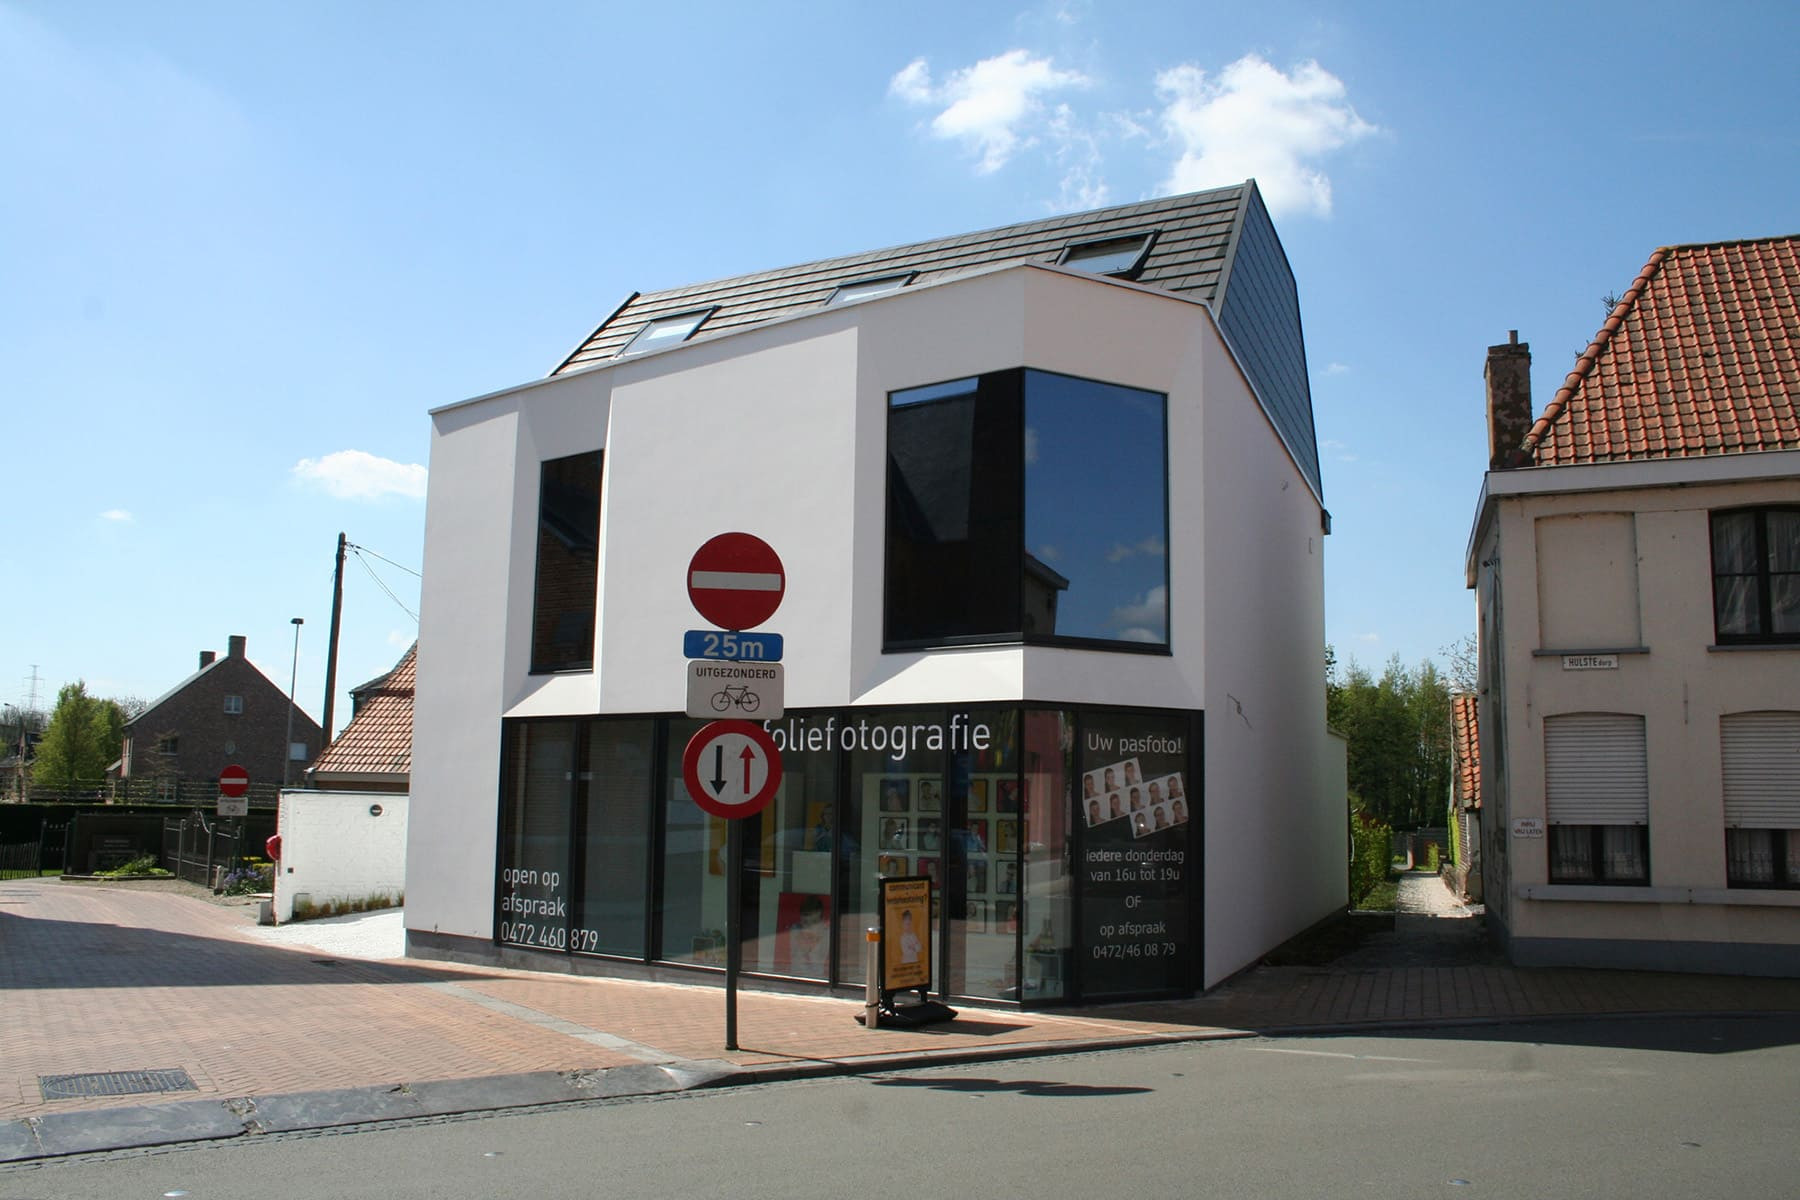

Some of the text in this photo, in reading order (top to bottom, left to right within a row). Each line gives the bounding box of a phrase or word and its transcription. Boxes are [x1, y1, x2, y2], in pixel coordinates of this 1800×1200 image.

[703, 633, 764, 658] 25m
[1568, 657, 1598, 667] HULSTE
[696, 667, 776, 679] UITGEZONDERD
[1088, 732, 1182, 756] Uw pasfoto!
[1086, 848, 1185, 864] iedere donderdag
[503, 868, 560, 892] open op
[1090, 868, 1180, 881] van 16u tot 19u
[502, 892, 566, 919] afspraak
[1125, 895, 1142, 908] OF
[501, 921, 599, 951] 0472 460 879
[1099, 921, 1166, 938] op afspraak
[1093, 942, 1176, 960] 0472/46 08 79
